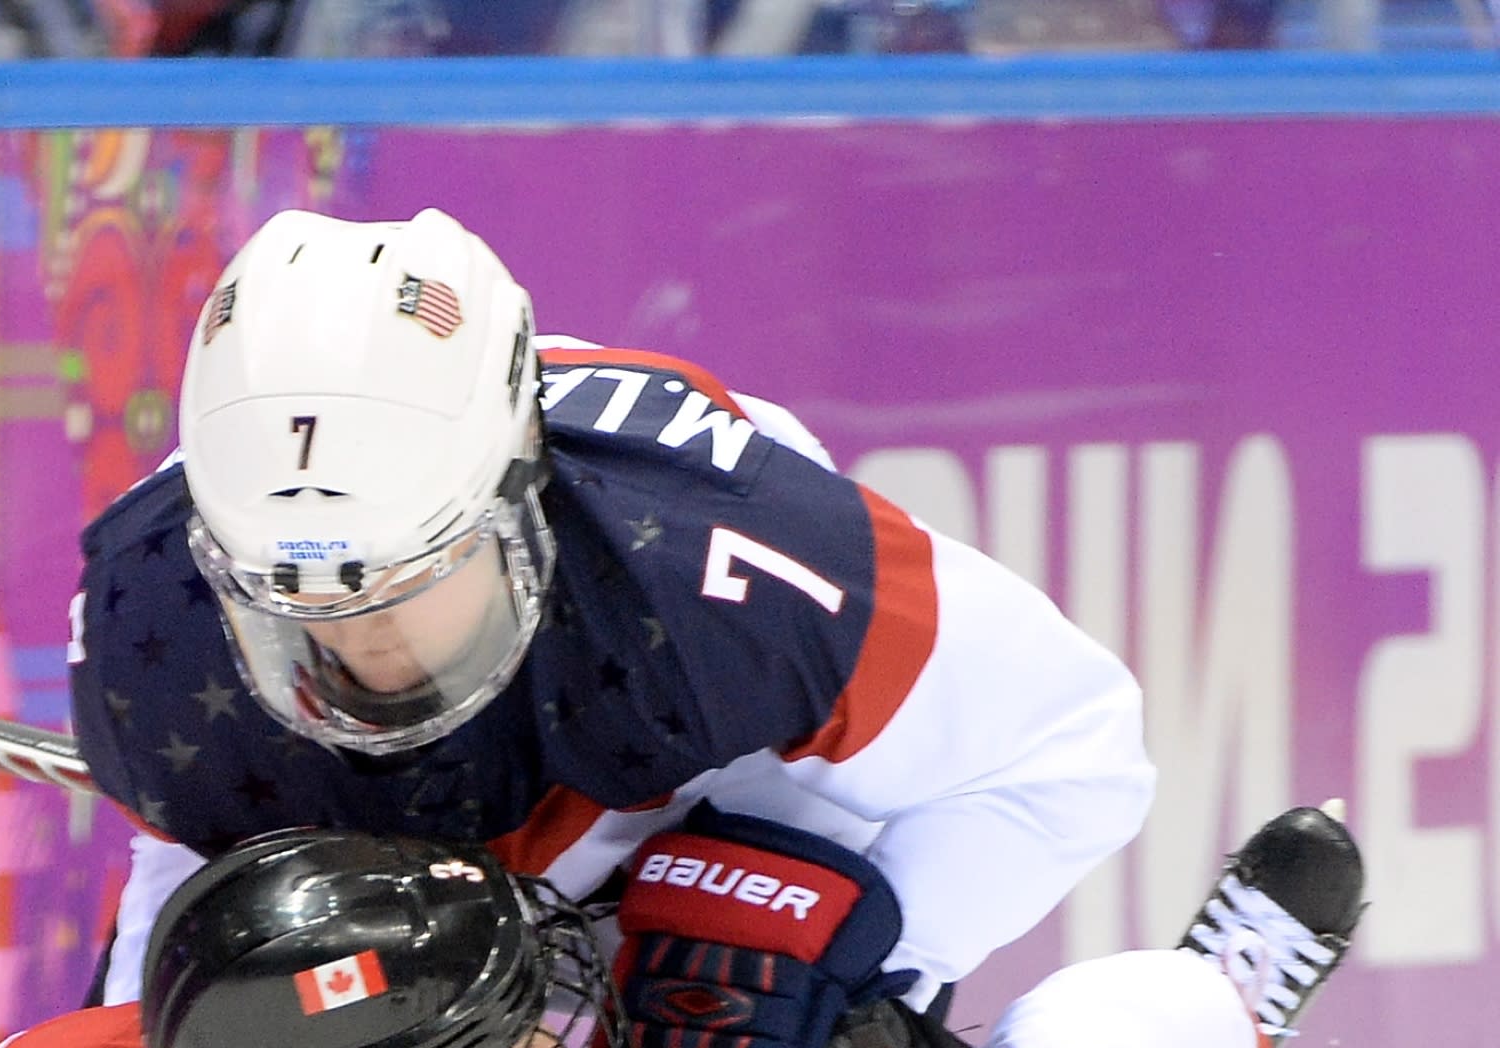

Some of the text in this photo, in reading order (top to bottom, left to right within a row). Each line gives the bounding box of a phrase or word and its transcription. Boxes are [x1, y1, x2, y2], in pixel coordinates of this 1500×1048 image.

[290, 415, 318, 471] 7
[701, 524, 846, 616] 7
[635, 851, 823, 923] BAUER
